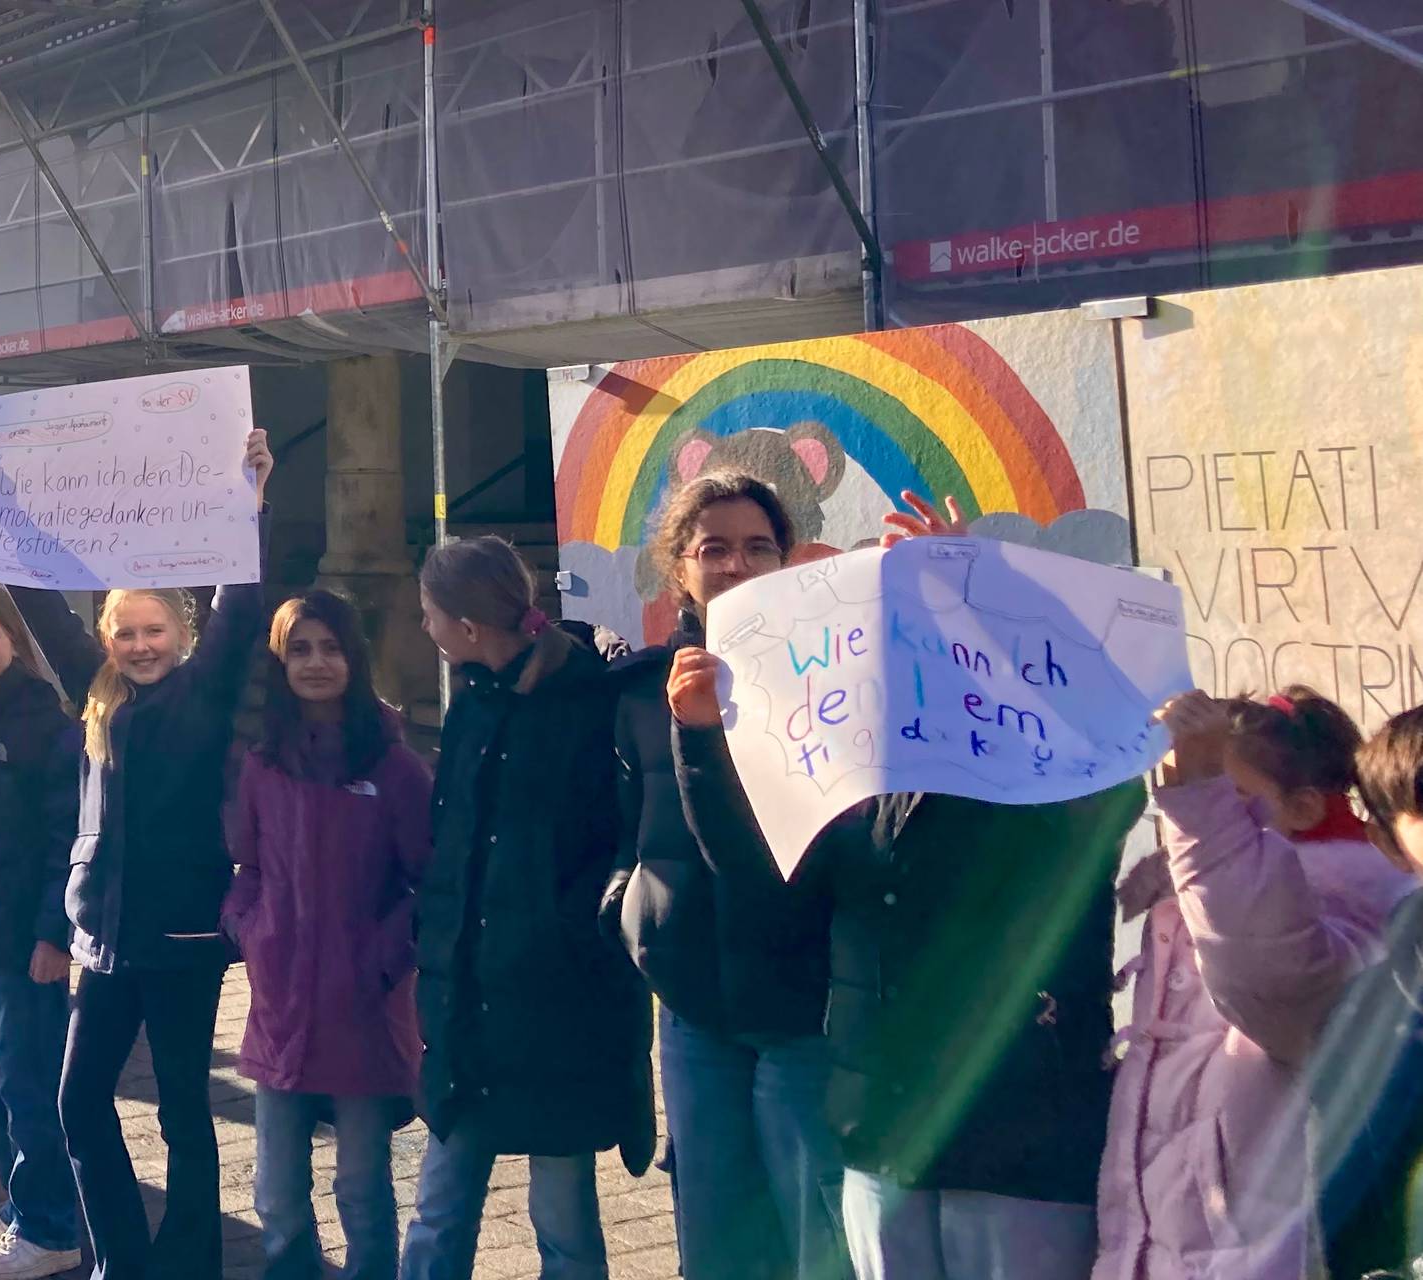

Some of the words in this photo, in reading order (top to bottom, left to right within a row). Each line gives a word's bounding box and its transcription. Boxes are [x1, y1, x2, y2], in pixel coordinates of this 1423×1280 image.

[957, 220, 1140, 265] walke-acker.de
[177, 387, 194, 406] SV
[0, 467, 33, 496] Wie
[43, 462, 89, 494] kann
[97, 456, 126, 488] ich
[133, 455, 172, 487] den
[177, 450, 225, 488] De-
[1146, 445, 1380, 535] PIETATI
[1175, 545, 1423, 631] VIRTV
[787, 624, 868, 676] Wie
